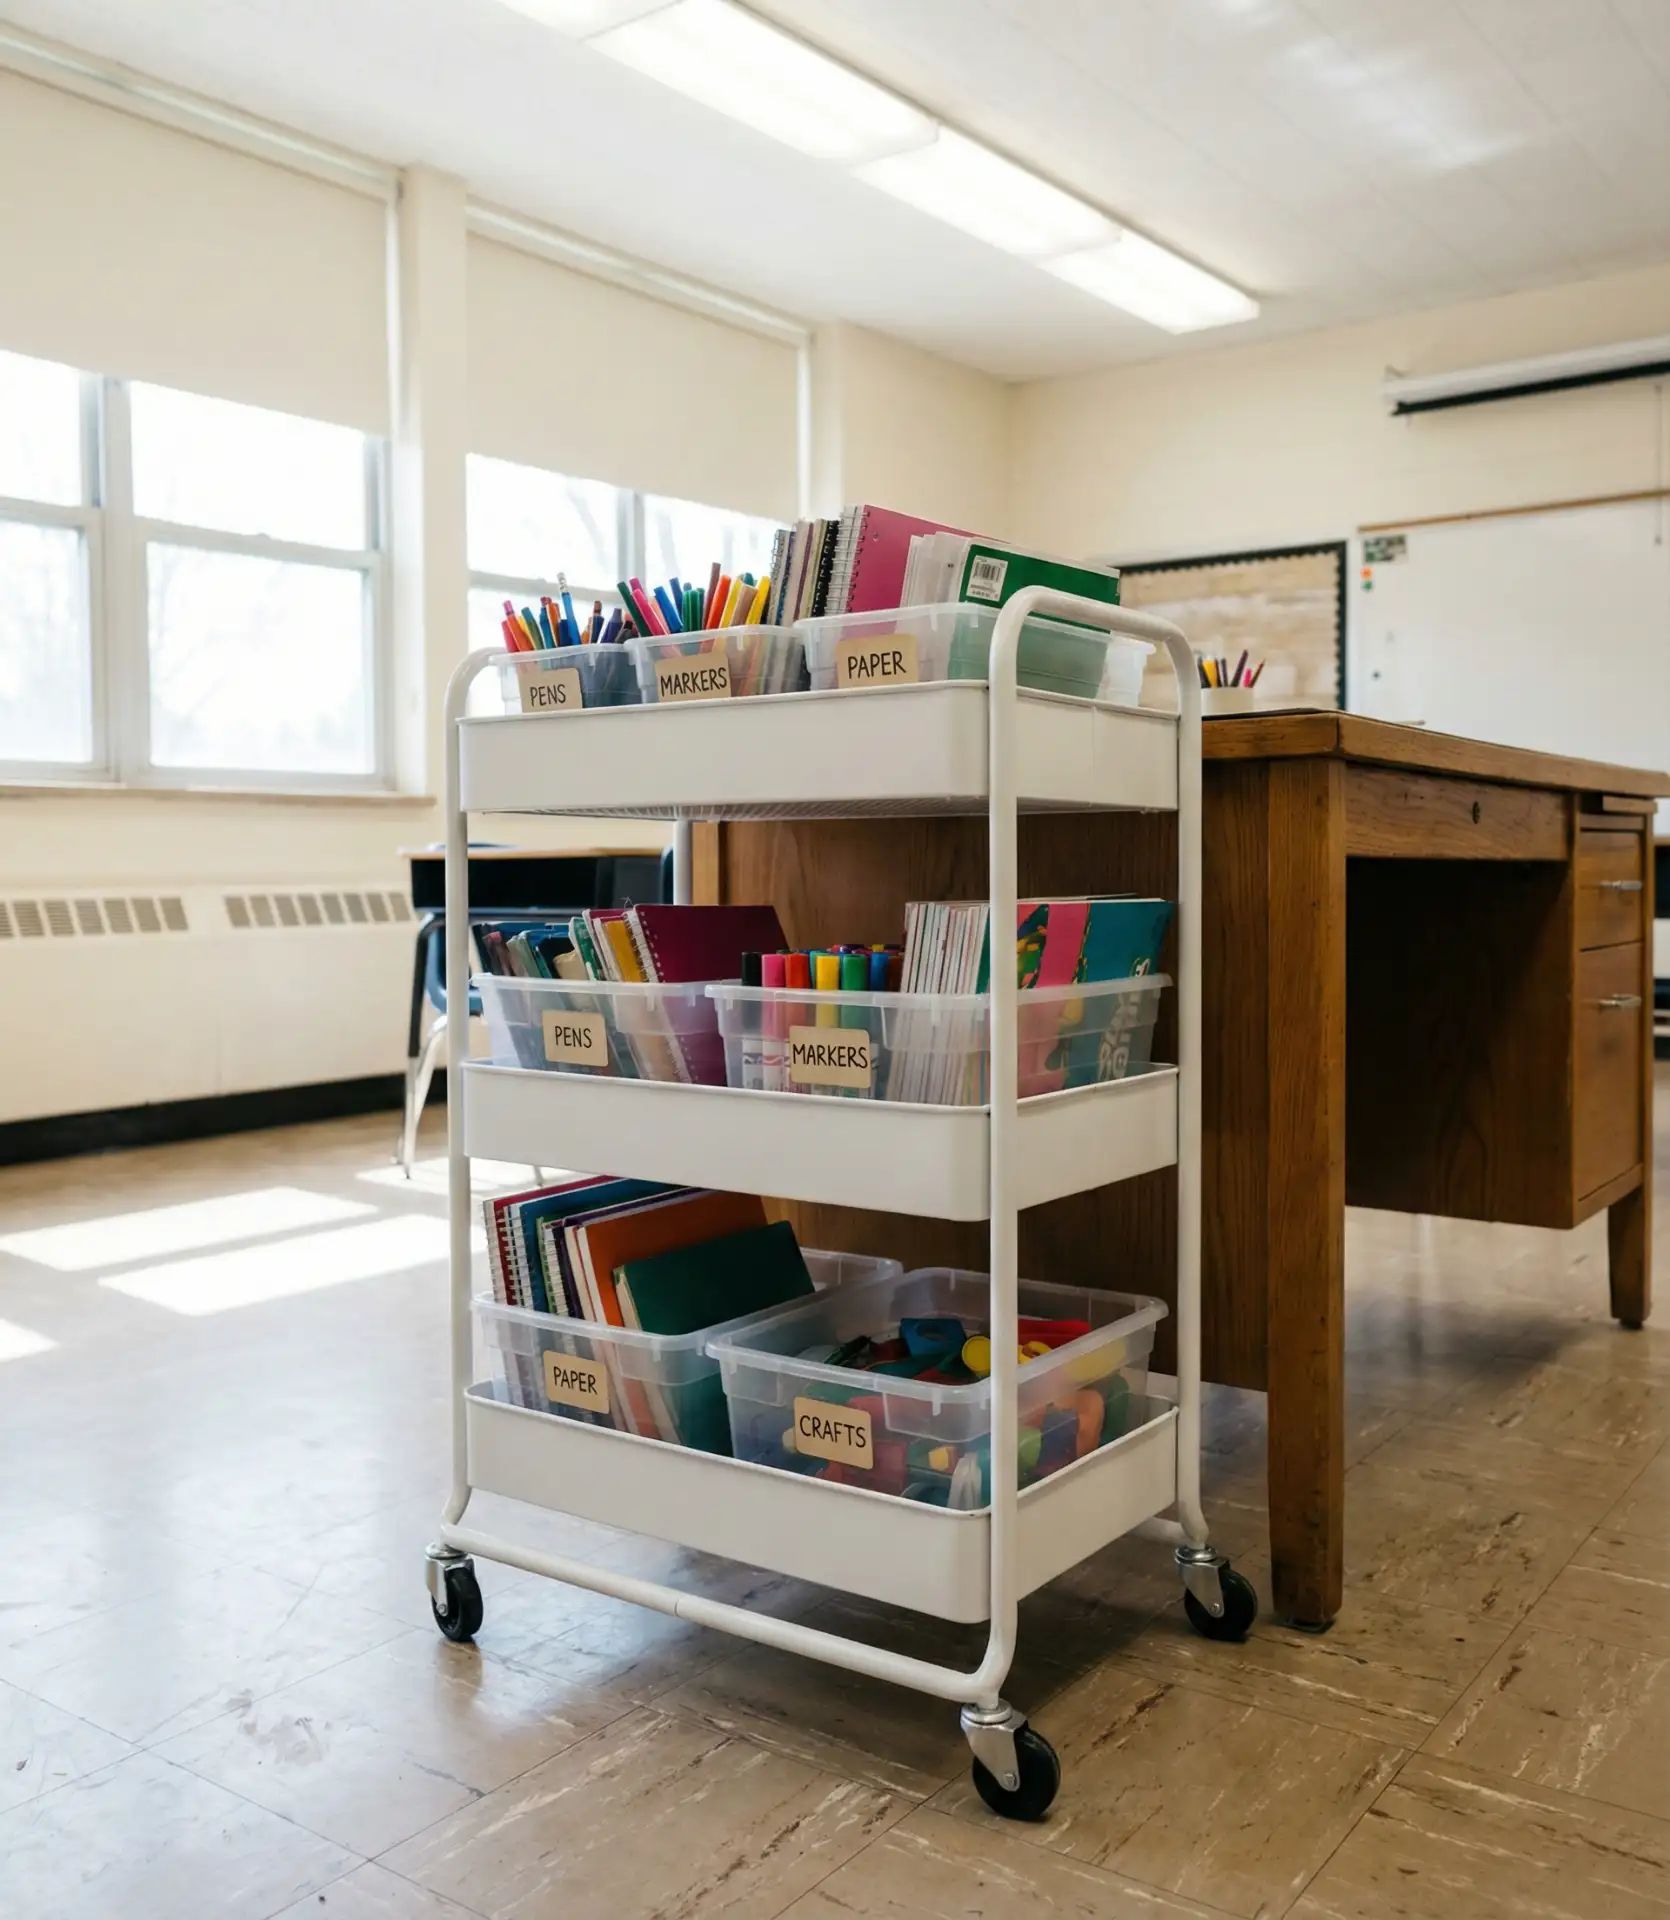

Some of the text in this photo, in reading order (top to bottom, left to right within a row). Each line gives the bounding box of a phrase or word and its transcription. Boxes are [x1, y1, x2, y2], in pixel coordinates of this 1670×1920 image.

[847, 650, 907, 680] PAPER
[530, 684, 566, 706] PENS
[660, 667, 728, 697] MARKERS
[554, 1025, 592, 1049] PENS
[792, 1043, 868, 1069] MARKERS
[553, 1366, 597, 1394] PAPER
[799, 1415, 867, 1448] CRAFTS
